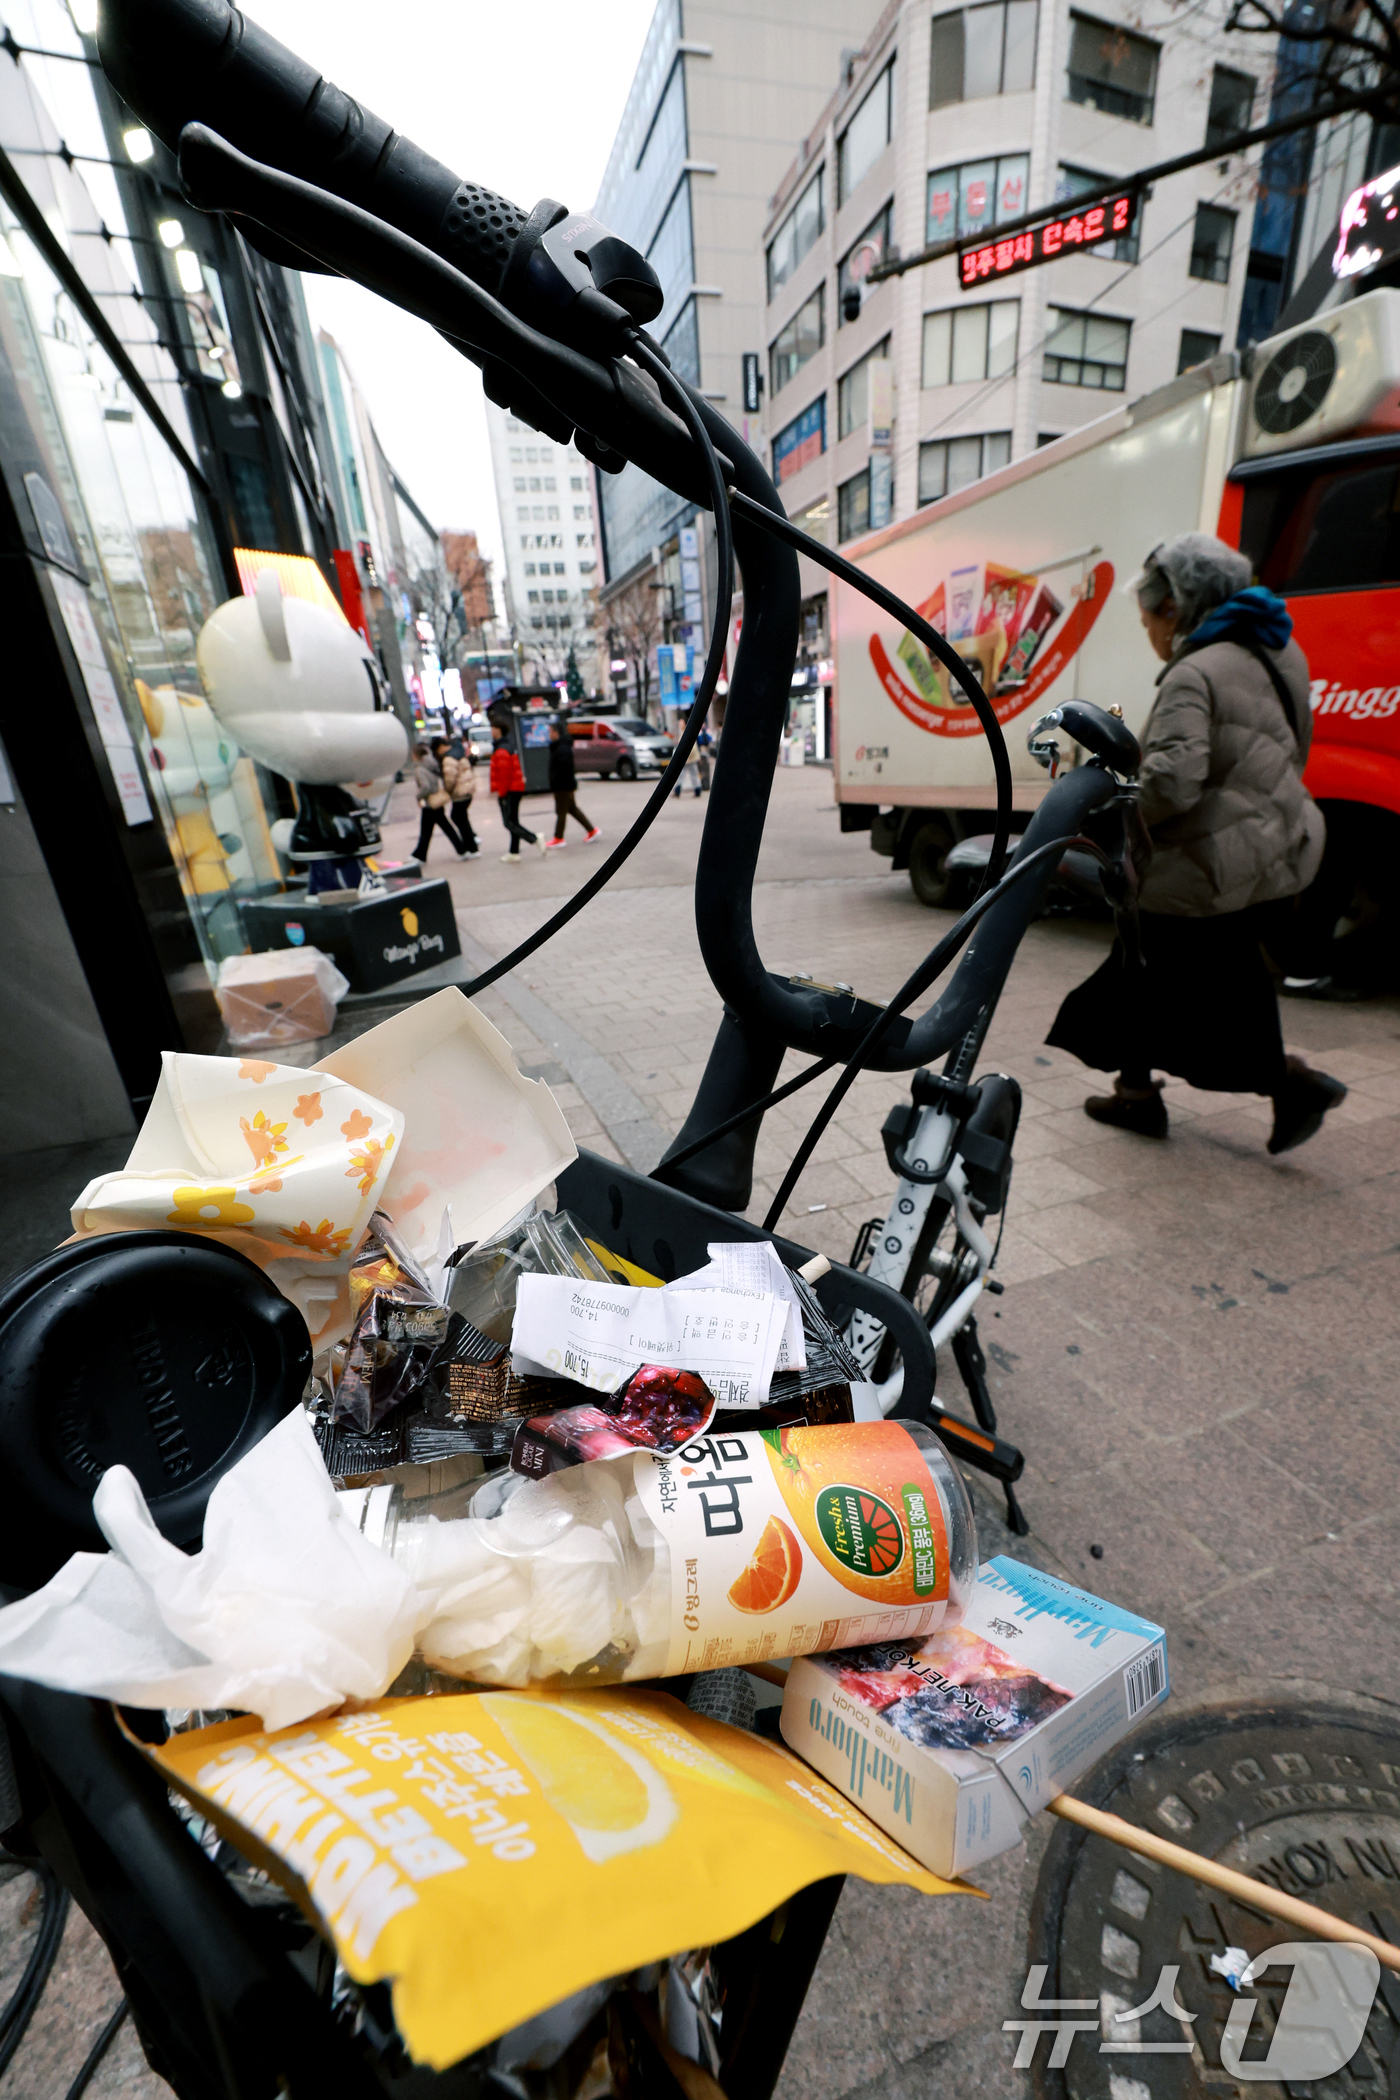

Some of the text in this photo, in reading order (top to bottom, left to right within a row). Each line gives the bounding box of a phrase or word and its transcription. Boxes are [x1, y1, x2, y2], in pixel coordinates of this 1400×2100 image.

[931, 176, 1023, 225] 부동산
[570, 1304, 598, 1321] 14,700
[360, 1343, 375, 1385] OHEM
[564, 1350, 589, 1377] 15,700
[533, 1446, 545, 1471] MINI
[845, 1496, 867, 1567] Premium
[904, 1493, 934, 1587] 비타민C 풍부 (36mg)
[685, 1558, 700, 1611] 빙그레
[977, 1573, 1118, 1649] Marlboro
[832, 1691, 870, 1729] touch
[955, 1693, 1007, 1729] РАК
[426, 1731, 531, 1797] 레몬즙
[809, 1697, 915, 1826] Marlboro
[268, 1730, 469, 1882] BETTER
[196, 1744, 419, 1963] NOTHING
